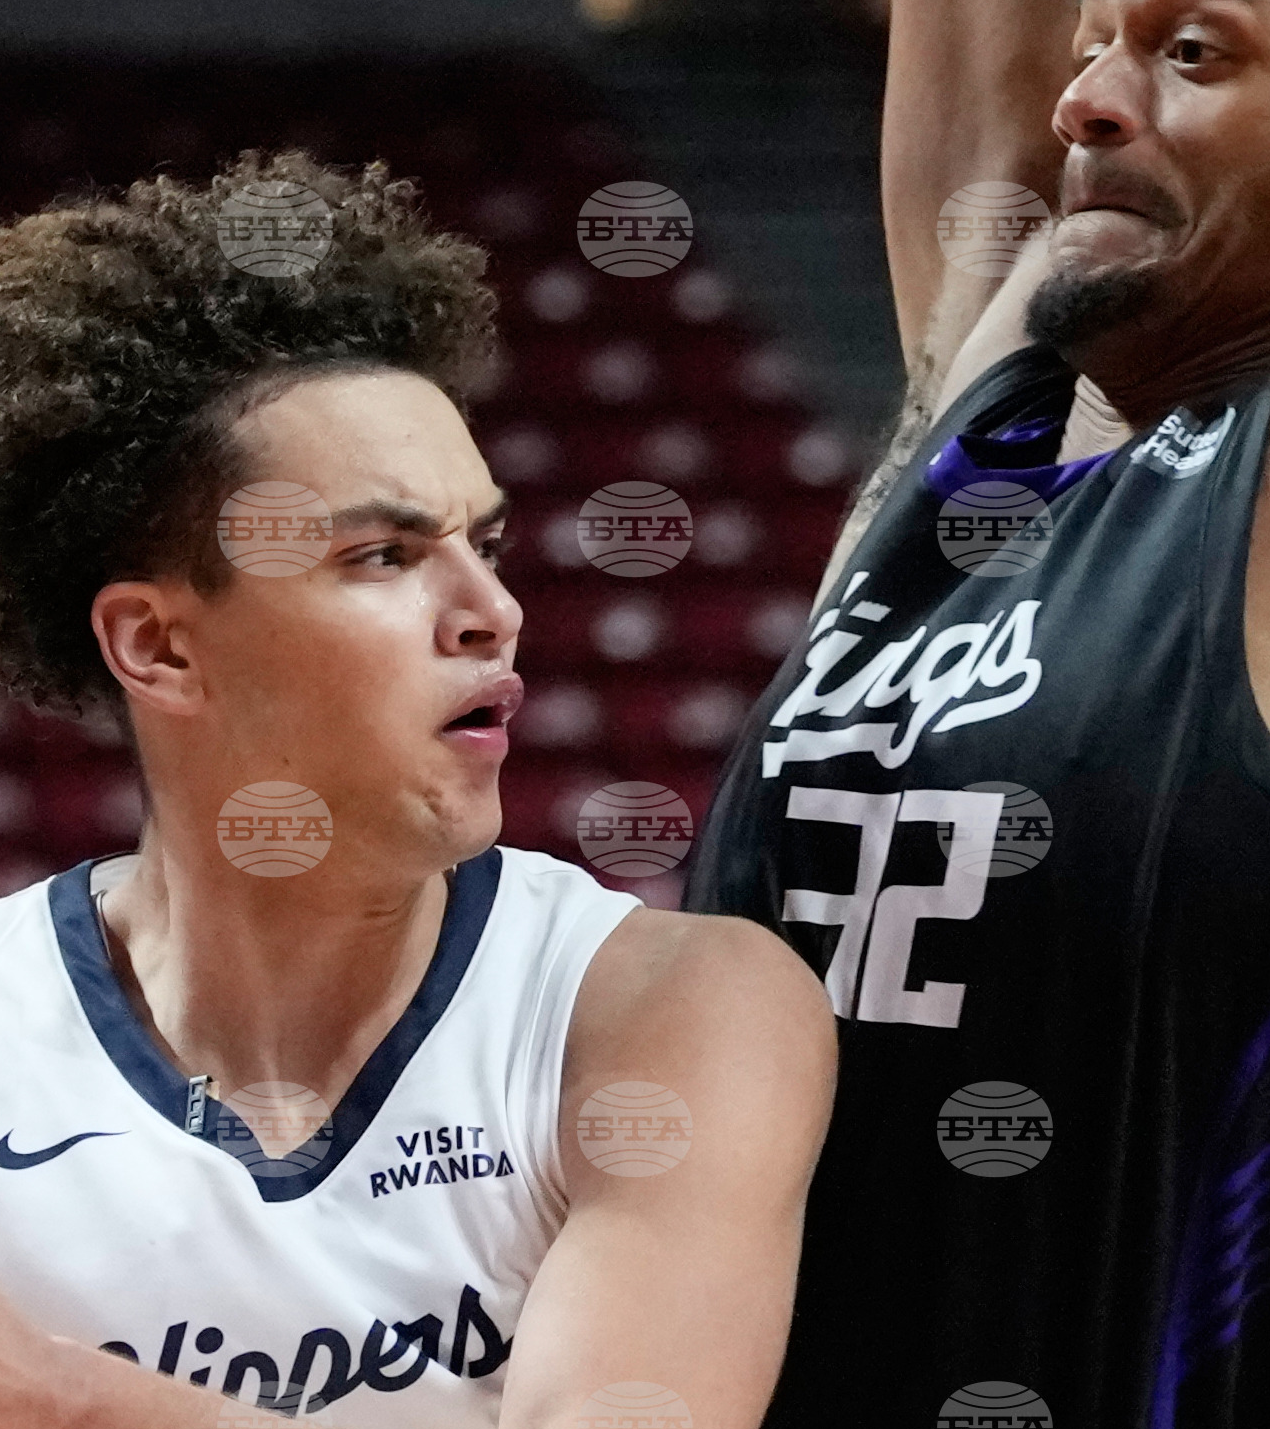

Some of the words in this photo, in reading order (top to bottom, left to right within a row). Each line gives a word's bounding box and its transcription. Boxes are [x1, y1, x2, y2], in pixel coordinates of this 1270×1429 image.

[781, 785, 1005, 1029] 32
[370, 1150, 515, 1199] RWANDA
[395, 1125, 485, 1158] VISIT
[97, 1283, 516, 1419] lippers
